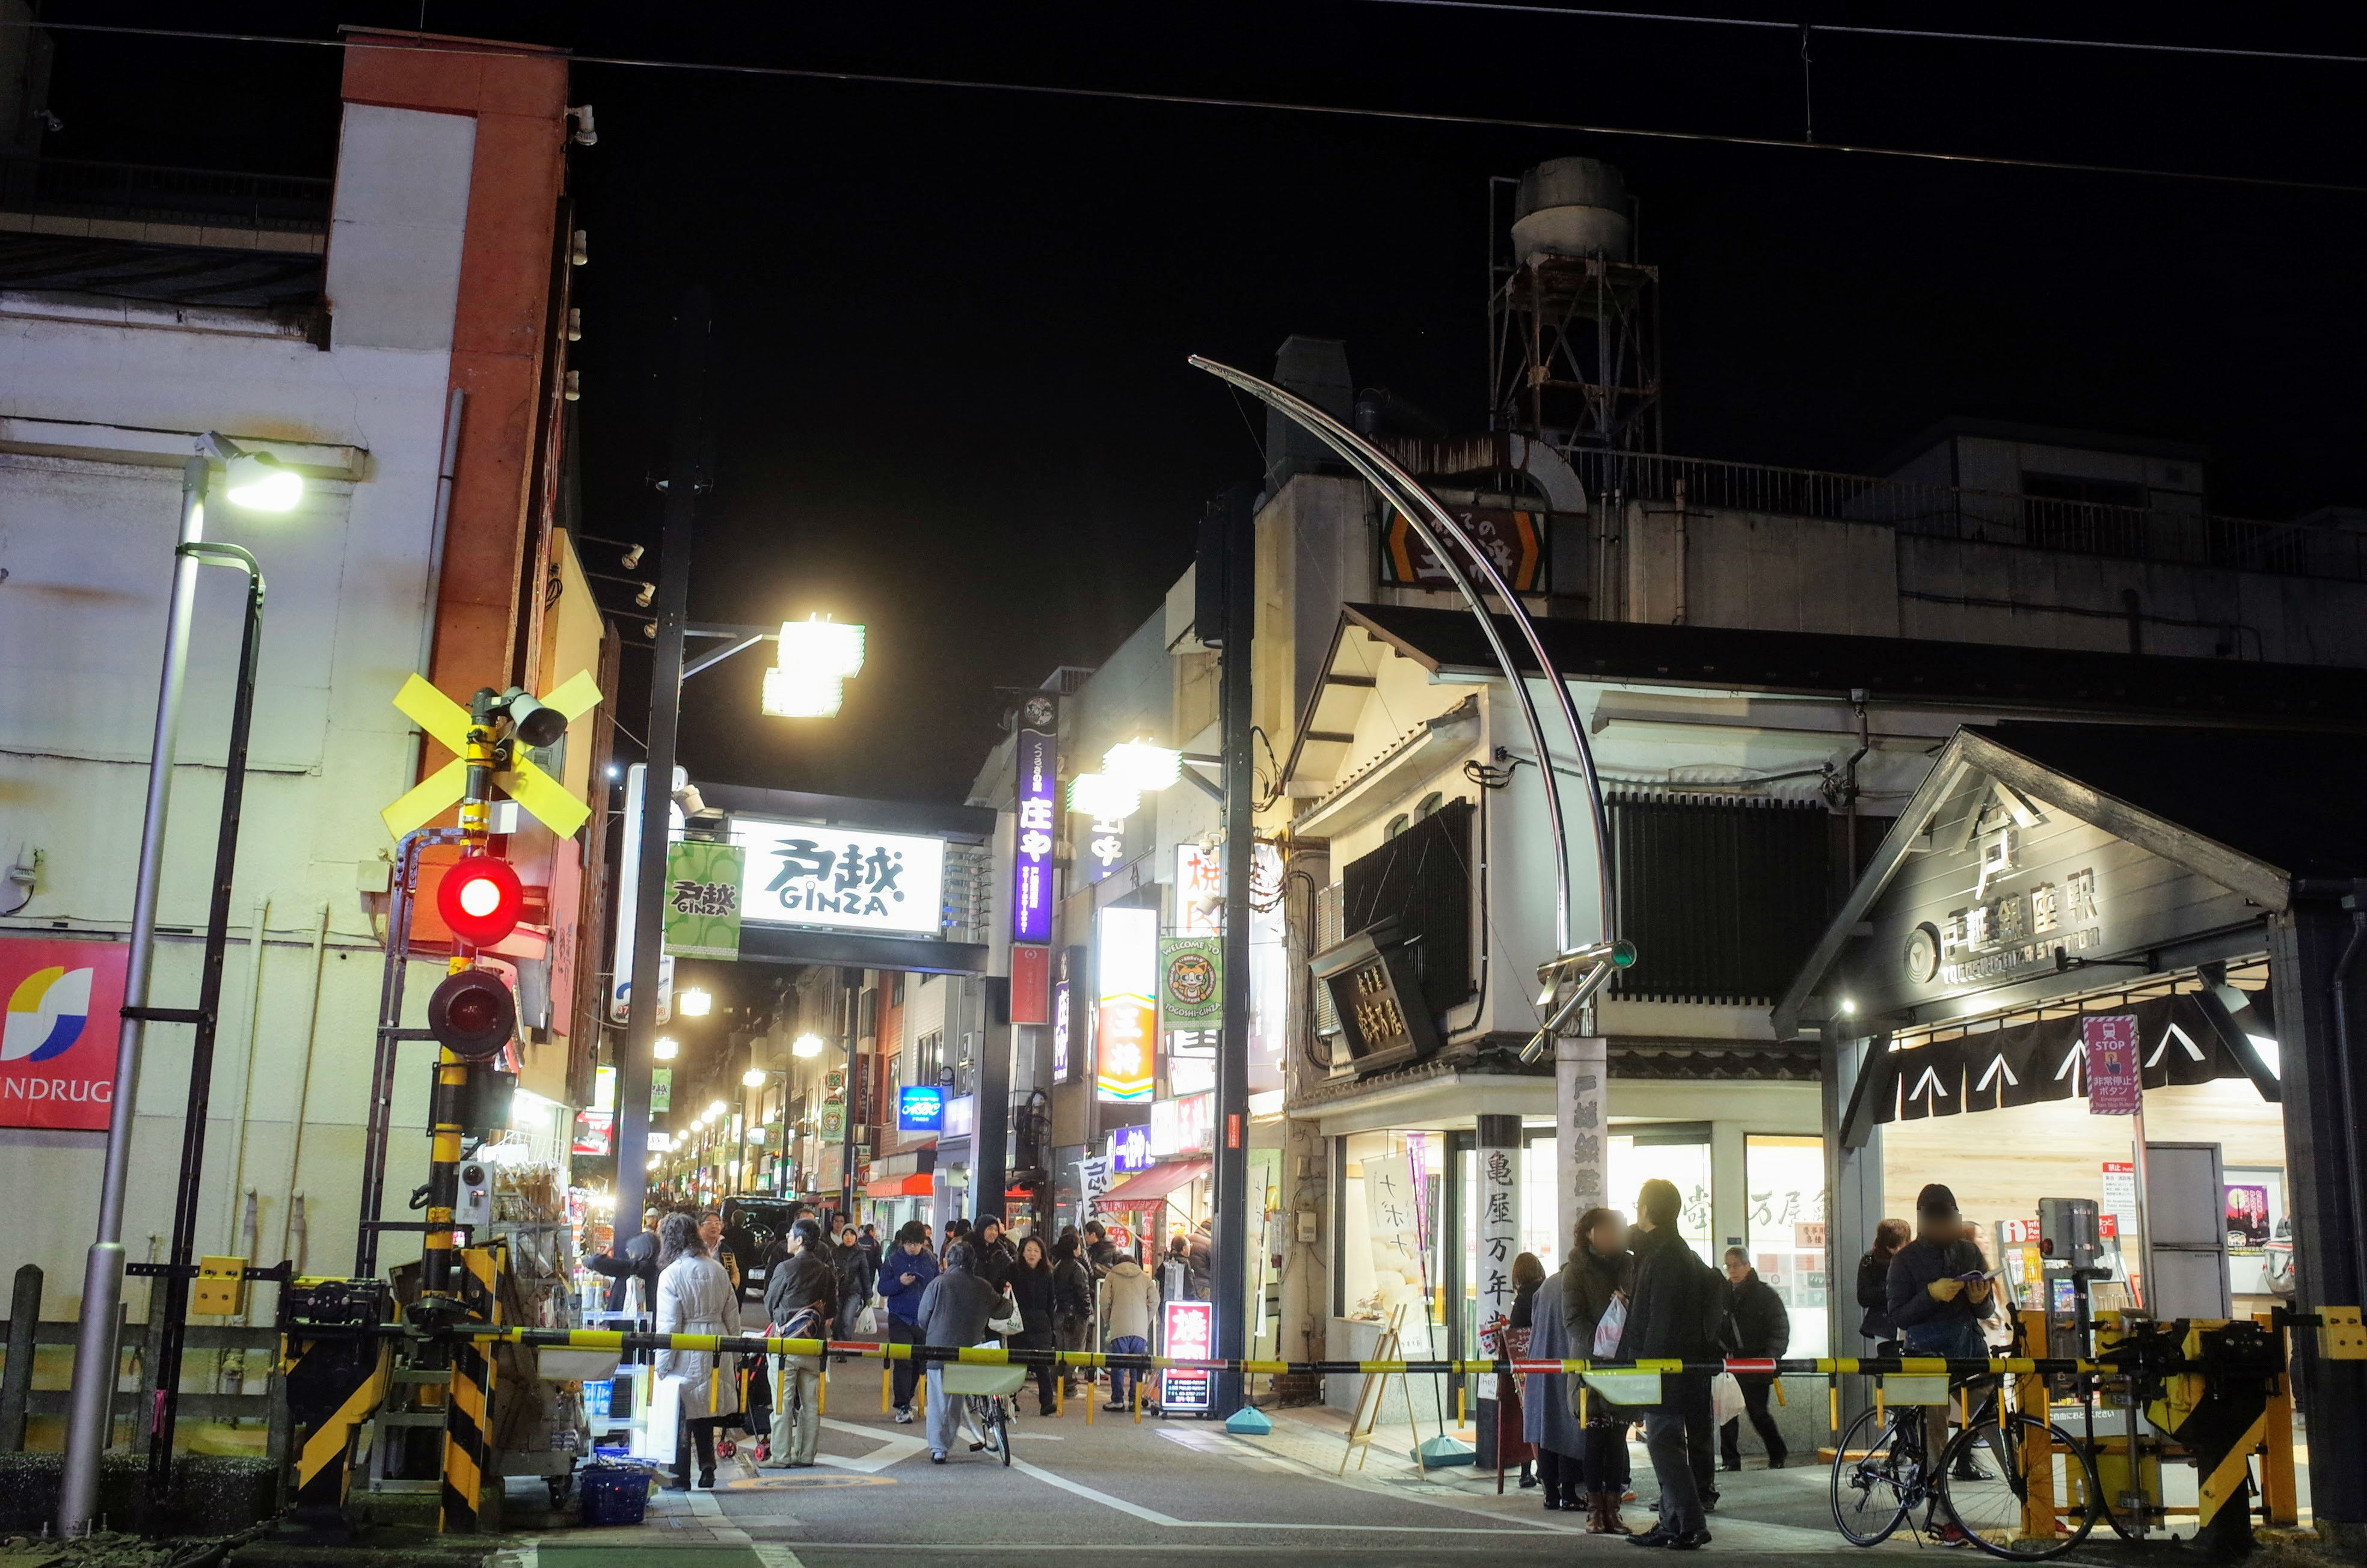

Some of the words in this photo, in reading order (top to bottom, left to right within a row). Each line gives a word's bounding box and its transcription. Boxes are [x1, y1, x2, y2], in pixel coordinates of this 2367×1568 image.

[1020, 797, 1053, 862] 庄や
[1940, 874, 2098, 961] 戸越銀座駅
[1162, 941, 1204, 956] WELCOME
[1208, 945, 1220, 955] TO
[1165, 1002, 1221, 1017] TOGOSHI-GINZA
[2095, 1041, 2125, 1051] STOP
[2093, 1076, 2132, 1086] 非常停止
[0, 1077, 112, 1103] NDRUG
[2099, 1086, 2128, 1096] ボタン
[1380, 1174, 1408, 1257] ナボナ
